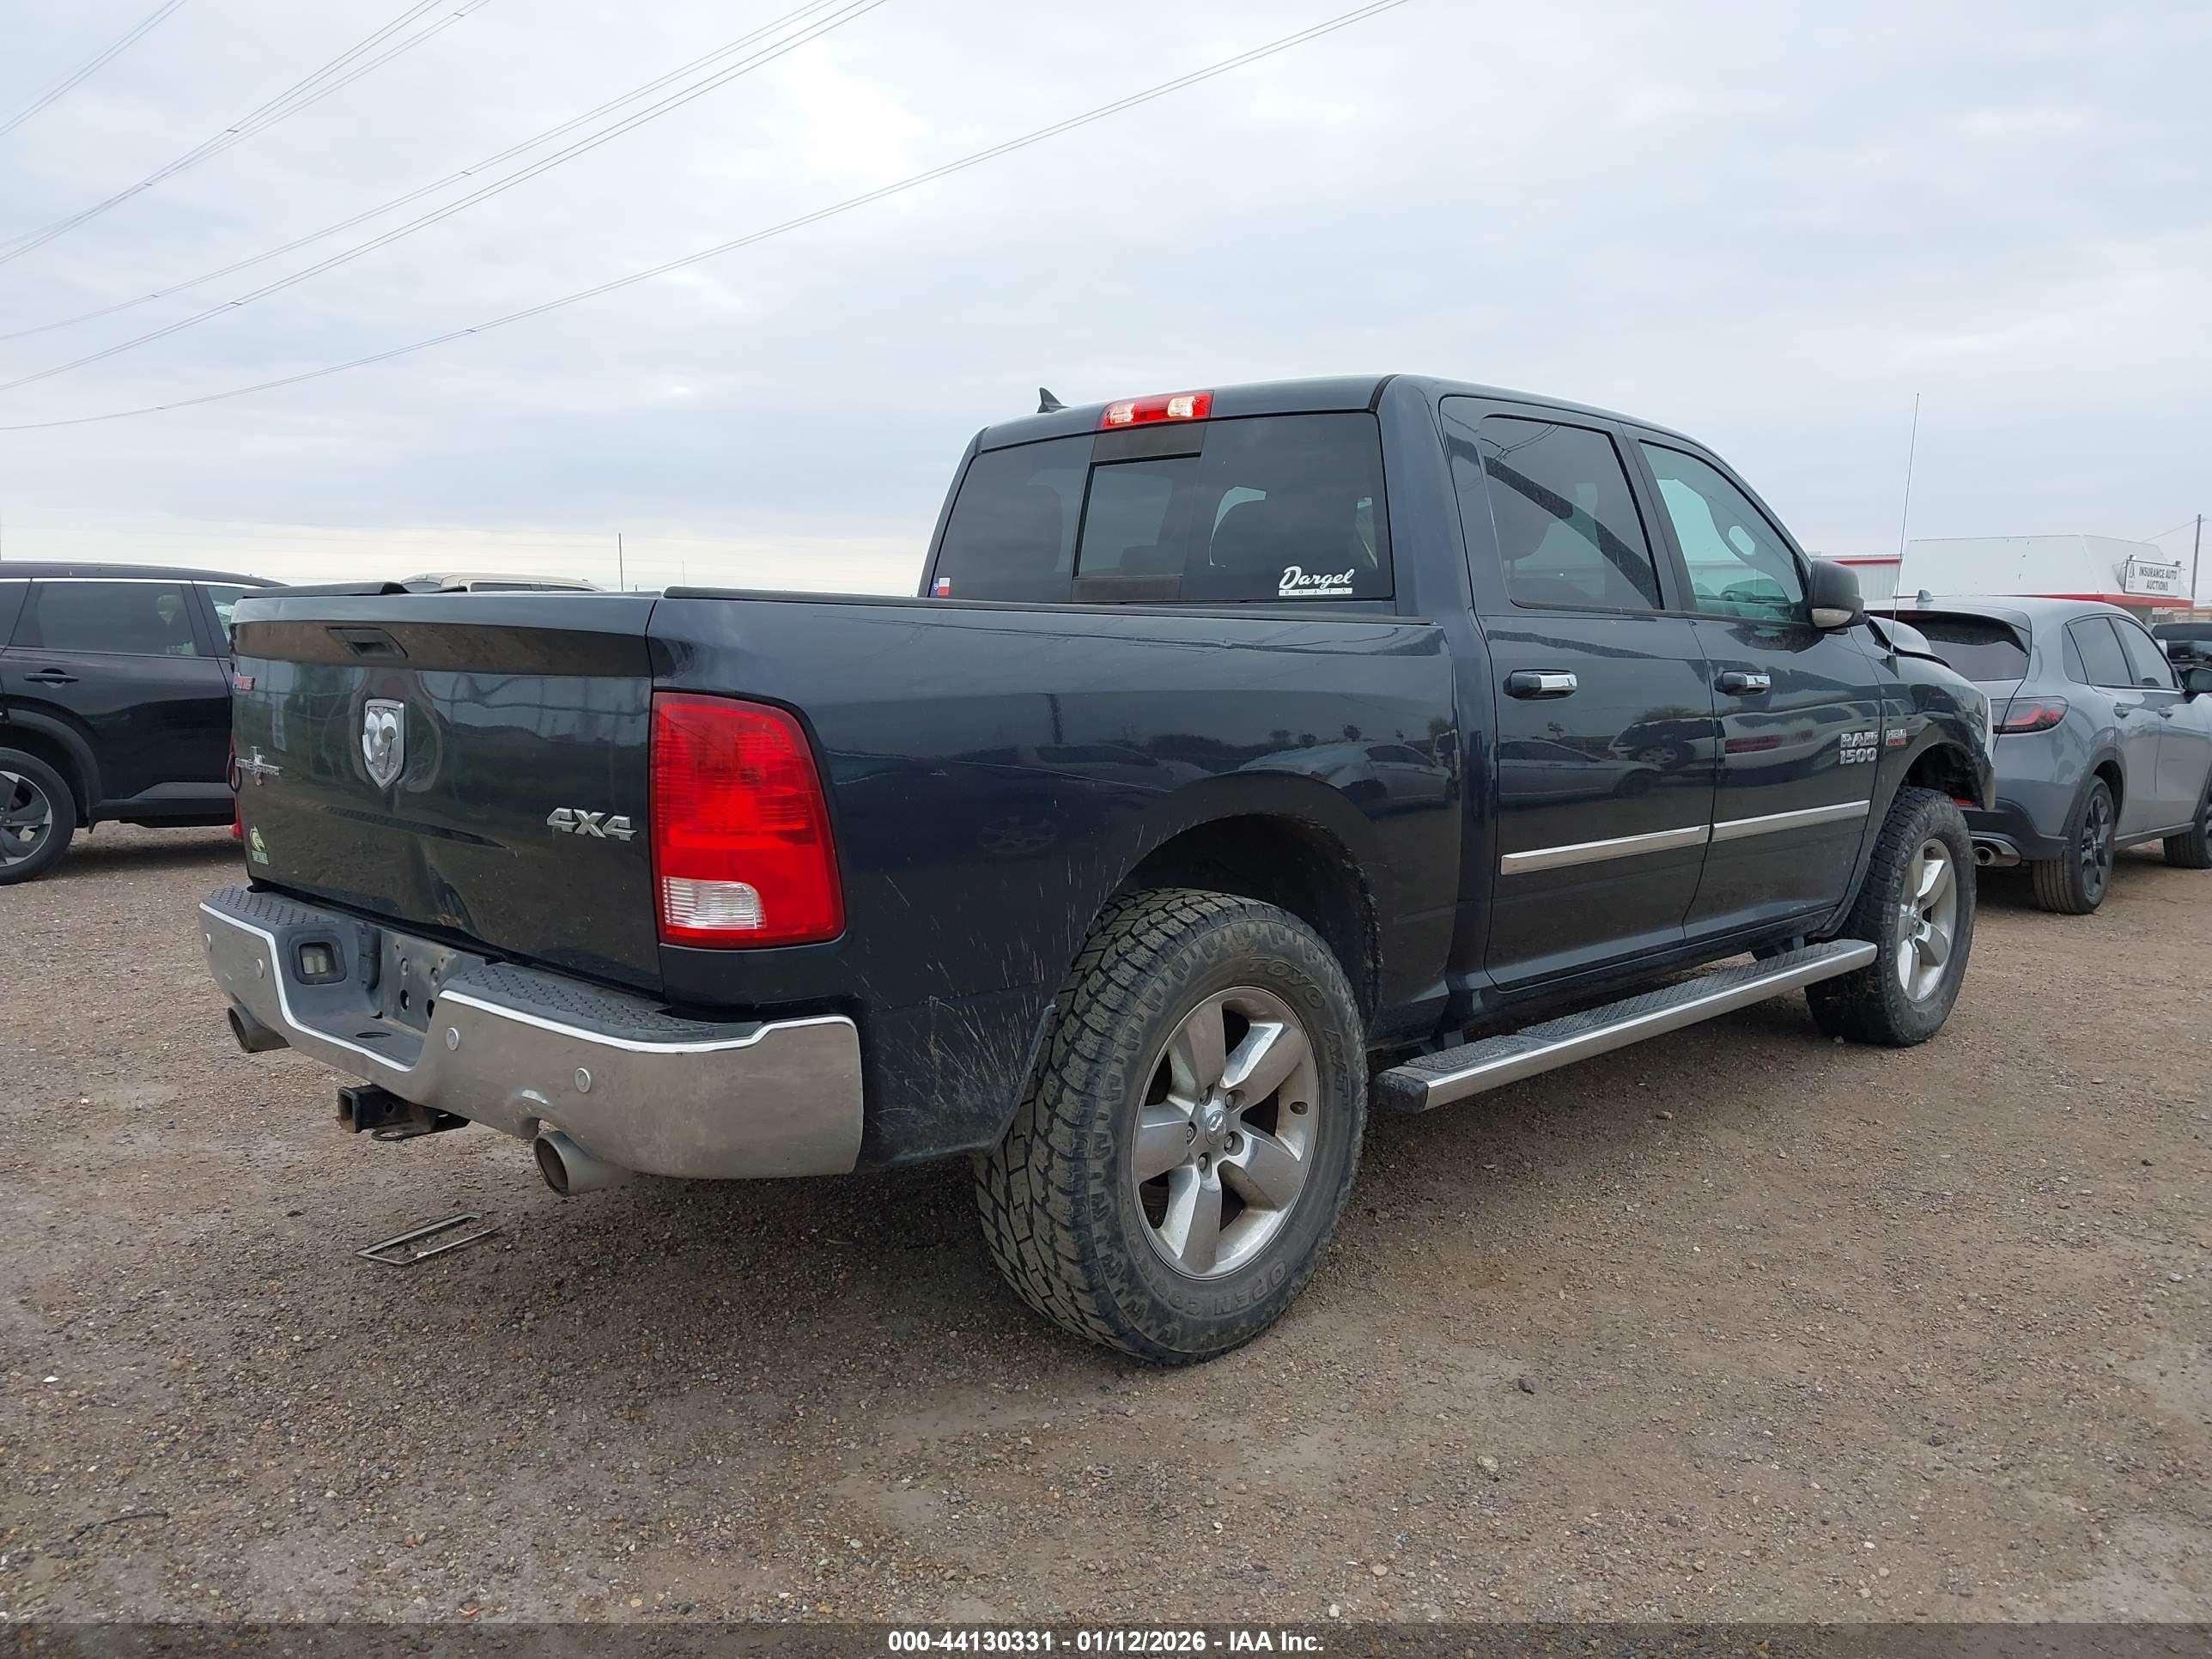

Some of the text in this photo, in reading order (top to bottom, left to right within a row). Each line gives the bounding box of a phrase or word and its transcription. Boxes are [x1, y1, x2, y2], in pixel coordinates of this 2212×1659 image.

[1279, 566, 1355, 590] Dargel
[2139, 566, 2166, 579] INSURANCE
[2166, 568, 2177, 580] AUTO
[2146, 579, 2169, 592] AUCTIONS
[1840, 732, 1878, 748] RAM
[1839, 747, 1877, 765] 1500
[1214, 1260, 1288, 1316] OPEN
